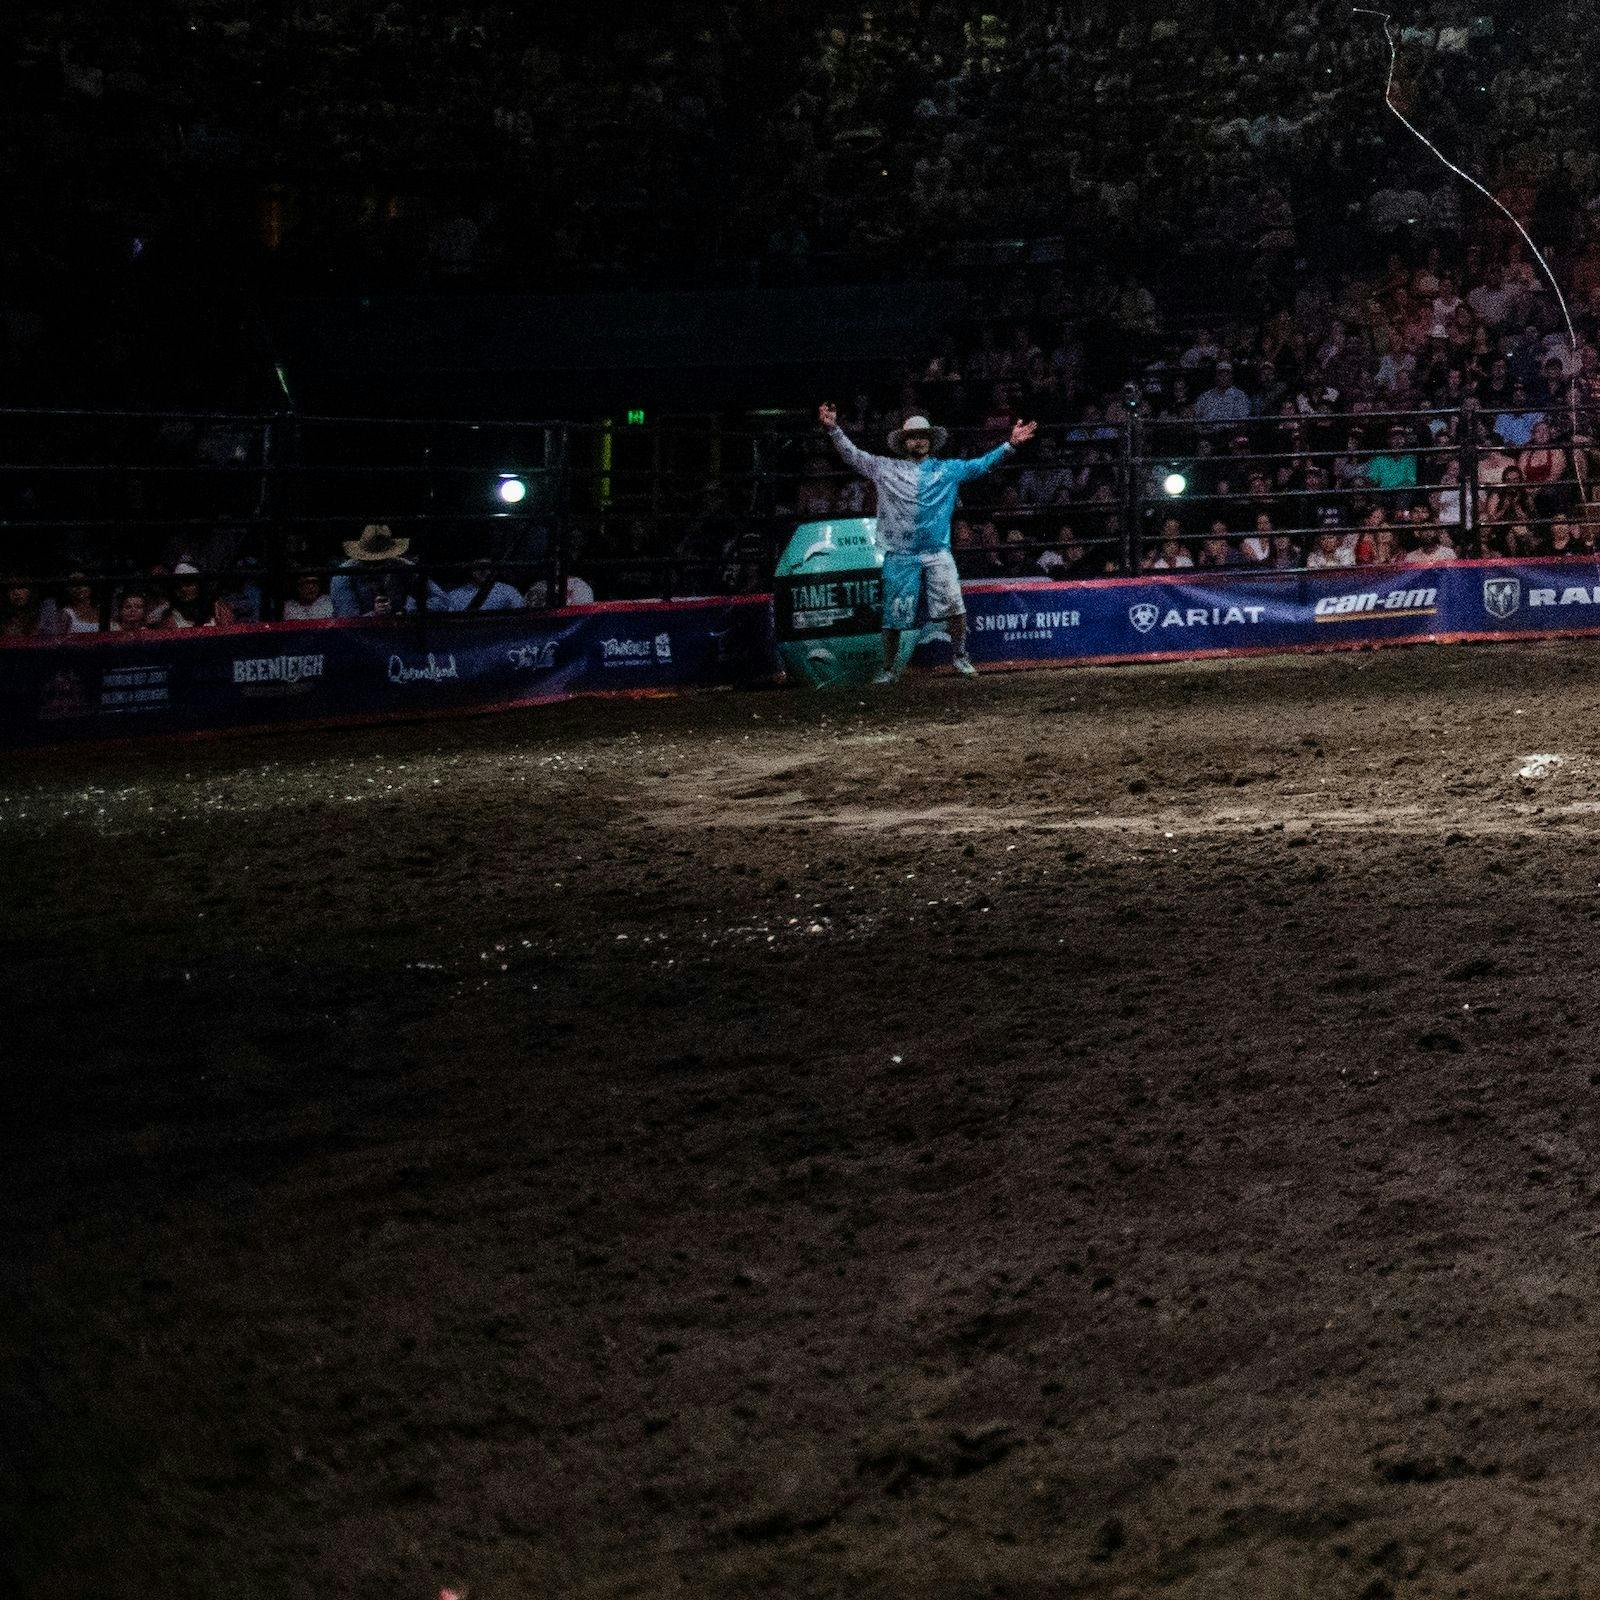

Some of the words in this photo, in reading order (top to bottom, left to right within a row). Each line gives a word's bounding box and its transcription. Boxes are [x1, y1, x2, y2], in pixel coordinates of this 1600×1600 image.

[838, 536, 867, 546] SNOW
[791, 583, 838, 609] TAME
[1314, 588, 1438, 615] can-am
[975, 613, 1029, 632] SNOWY
[1036, 610, 1081, 628] RIVER
[1161, 606, 1265, 628] ARIAT
